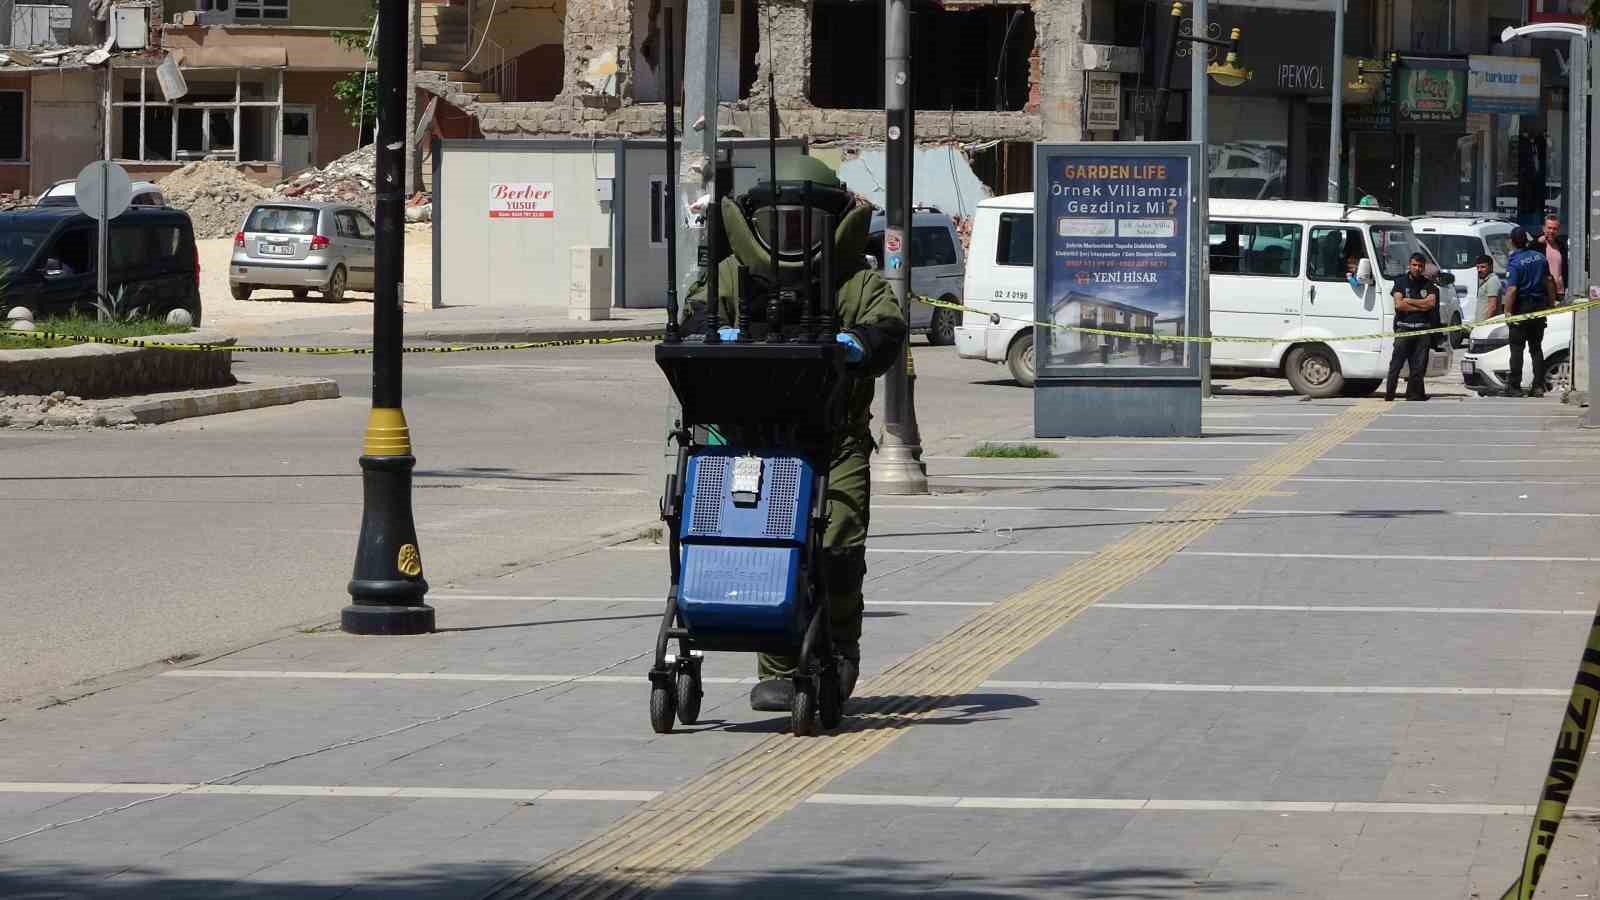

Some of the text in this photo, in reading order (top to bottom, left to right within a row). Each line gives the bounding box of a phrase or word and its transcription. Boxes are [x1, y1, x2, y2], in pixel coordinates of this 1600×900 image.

[1064, 165, 1167, 180] GARDEN LIFE
[491, 184, 552, 200] Berber
[1051, 180, 1183, 198] Örnek Villamızı
[1067, 199, 1178, 215] Gezdiniz Mi?
[1093, 270, 1158, 283] YENİ HİSAR
